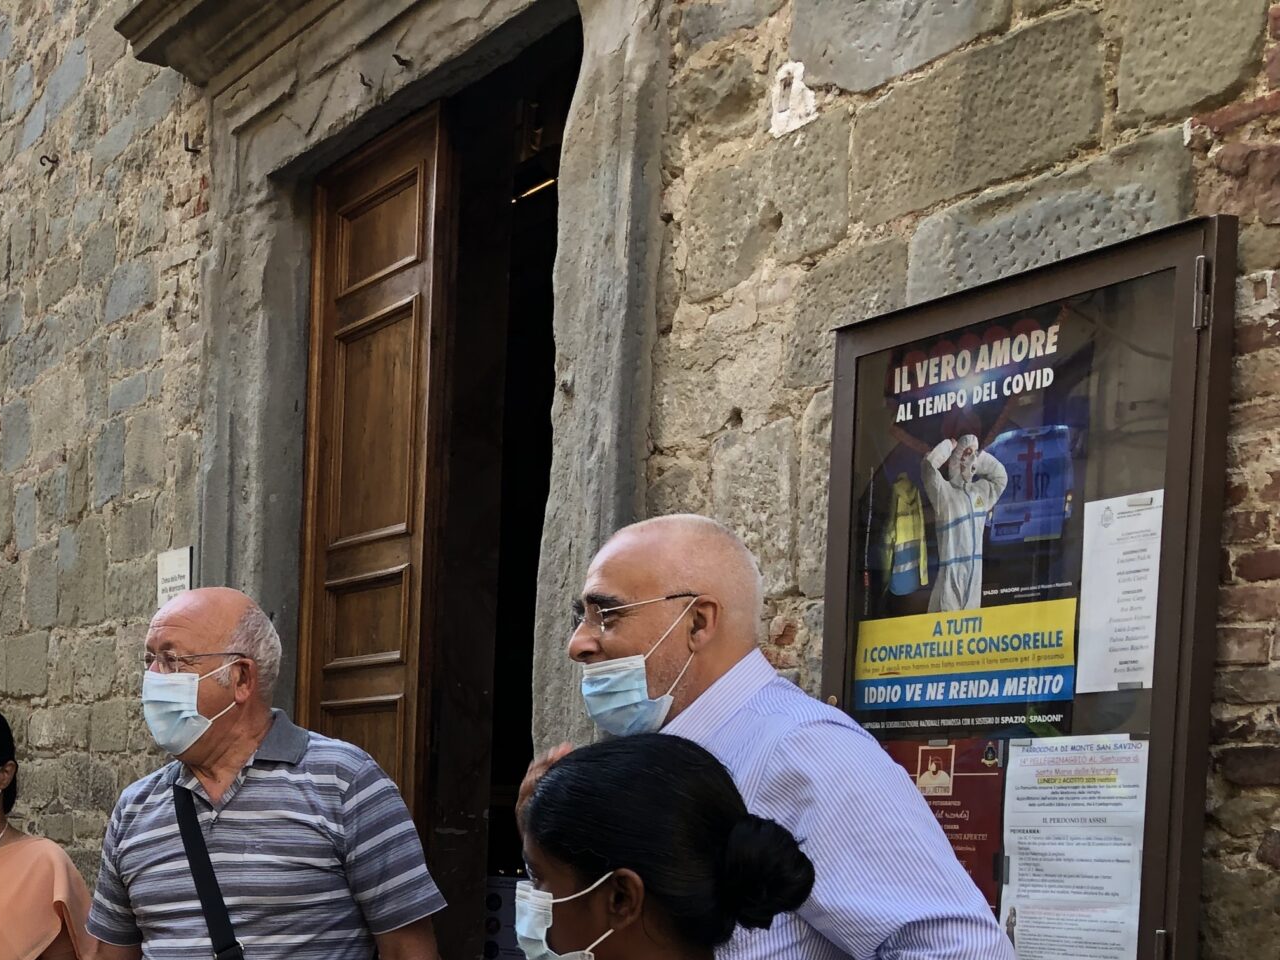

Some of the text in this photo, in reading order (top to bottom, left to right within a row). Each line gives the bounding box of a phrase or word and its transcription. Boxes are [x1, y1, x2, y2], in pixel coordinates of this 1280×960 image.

[893, 325, 1060, 394] IL VERO AMORE
[896, 367, 1055, 423] AL TEMPO DEL COVID
[932, 616, 983, 638] A TUTTI
[863, 630, 1064, 664] I CONFRATELLI E CONSORELLE
[864, 674, 1064, 704] IDDIO VE NE RENDA MERITO
[1001, 715, 1026, 724] SPAZIO
[1070, 744, 1094, 752] MONTE
[1113, 742, 1143, 750] SAVINO
